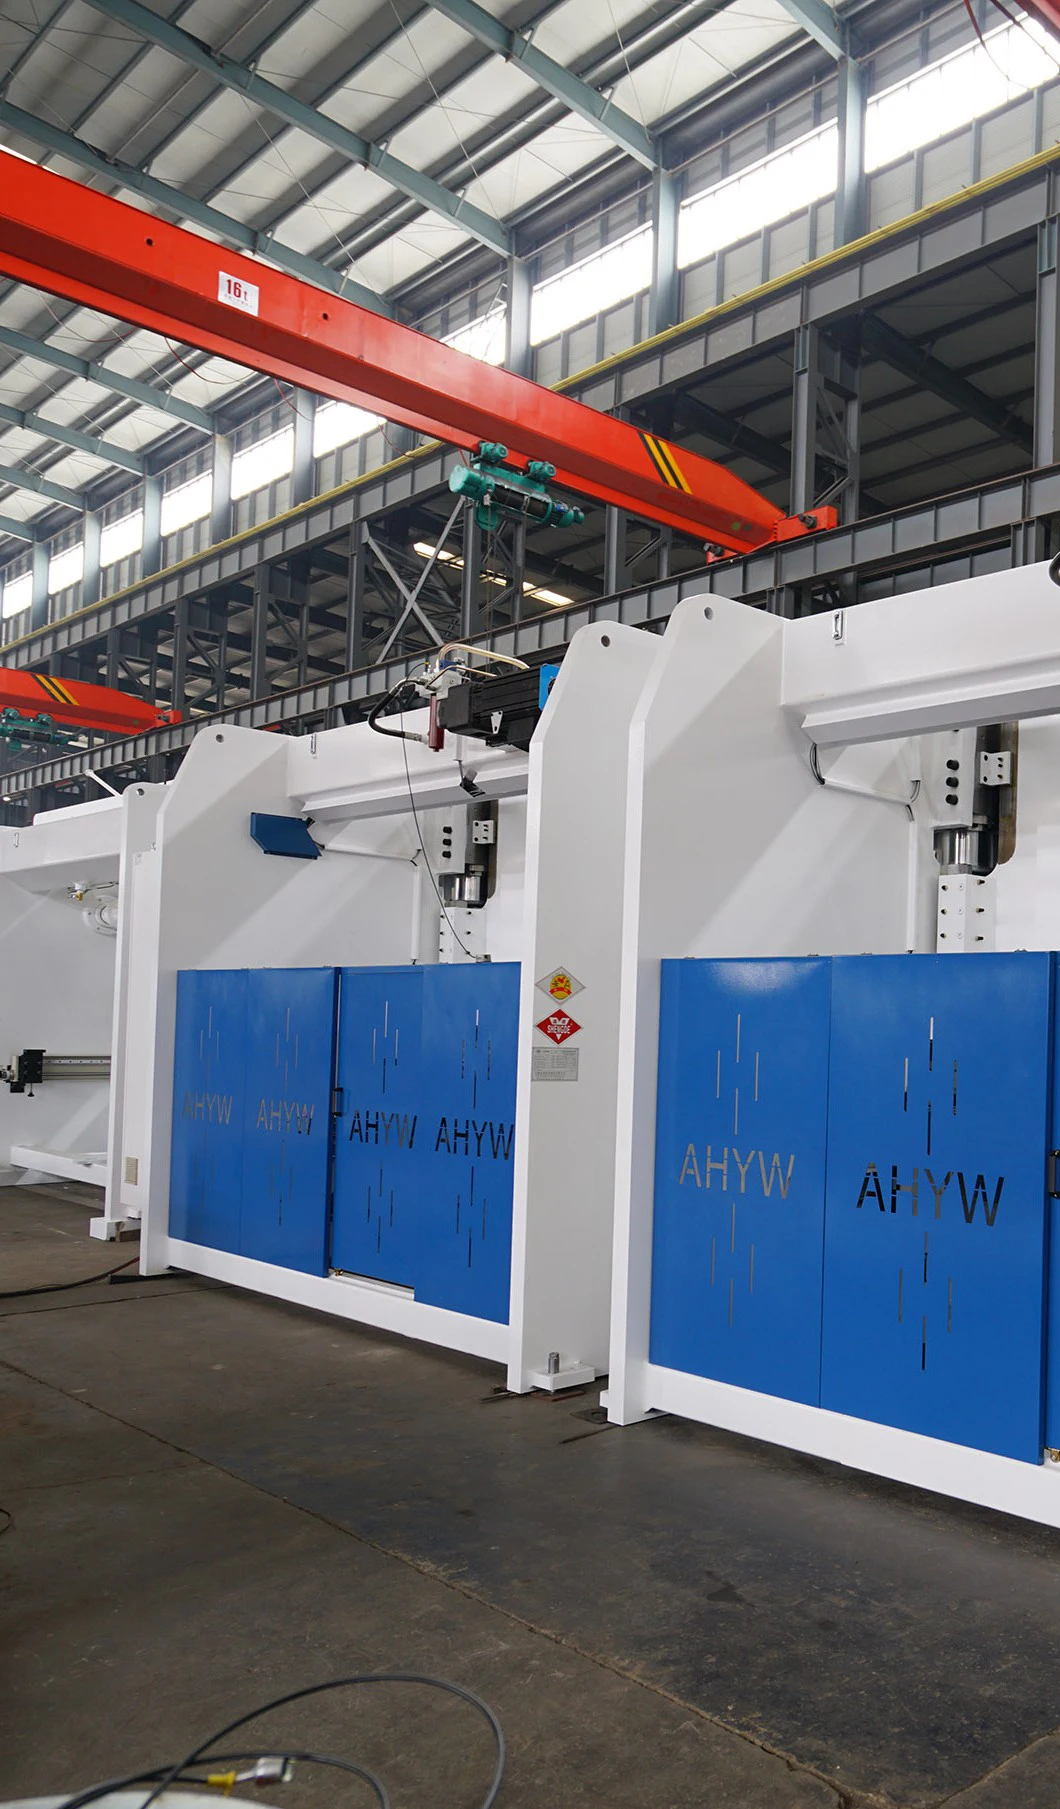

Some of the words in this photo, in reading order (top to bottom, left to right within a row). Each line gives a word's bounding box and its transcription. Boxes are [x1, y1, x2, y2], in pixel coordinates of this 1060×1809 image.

[182, 1091, 233, 1125] AHYW
[256, 1098, 315, 1135] AHYW
[349, 1109, 417, 1149] AHYW
[434, 1116, 514, 1160] AHYW
[679, 1143, 795, 1199] AHYW
[856, 1162, 1004, 1227] AHYW
